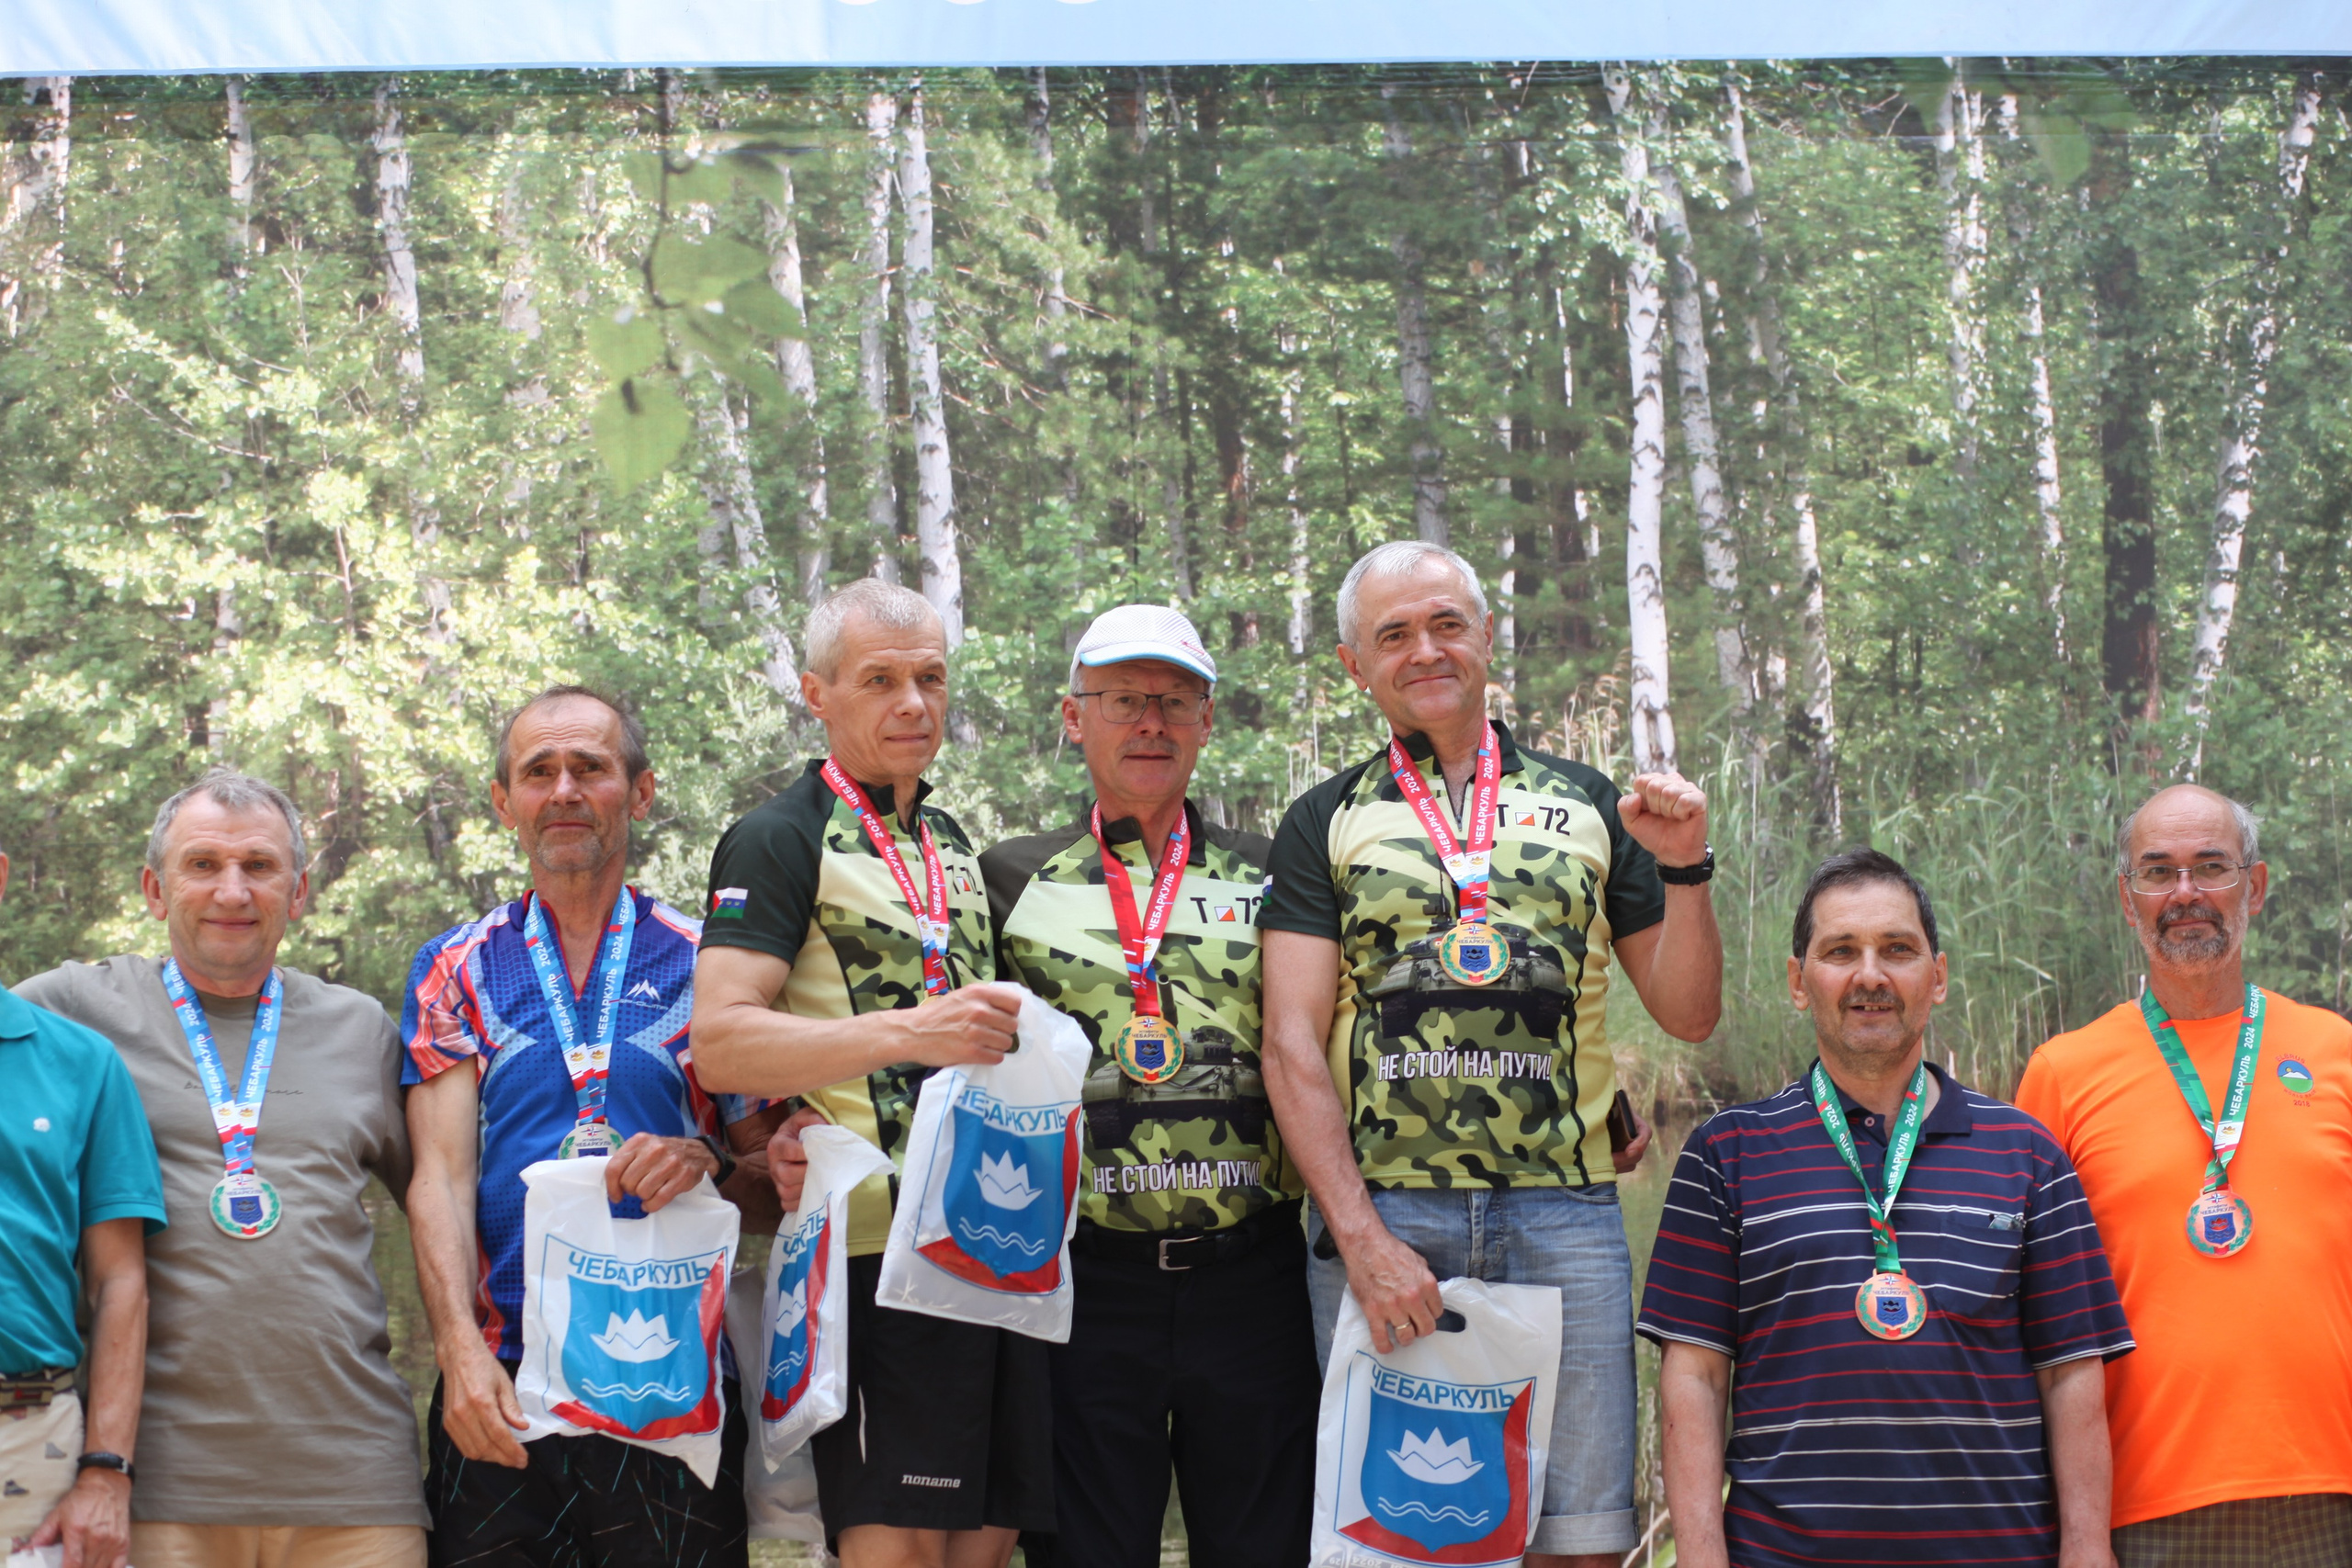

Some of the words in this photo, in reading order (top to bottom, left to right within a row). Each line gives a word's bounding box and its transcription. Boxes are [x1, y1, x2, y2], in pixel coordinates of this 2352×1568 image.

[1402, 771, 1420, 794] 2024
[1475, 786, 1491, 844] ЧЕБАРКУЛЬ
[1484, 758, 1495, 780] 2024
[863, 813, 885, 839] 2024
[1419, 797, 1452, 852] ЧЕБАРКУЛЬ
[1538, 806, 1570, 836] 72
[885, 845, 921, 910] ЧЕБАРКУЛЬ
[928, 854, 942, 915] ЧЕБАРКУЛЬ
[1148, 872, 1175, 931] ЧЕБАРКУЛЬ
[1170, 842, 1184, 866] 2024
[537, 941, 551, 966] 2024
[547, 973, 574, 1042] ЧЕБАРКУЛЬ
[596, 968, 617, 1038] ЧЕБАРКУЛЬ
[610, 936, 625, 961] 2024
[184, 1002, 200, 1026] 2024
[197, 1033, 222, 1098] ЧЕБАРКУЛЬ
[244, 1038, 268, 1098] ЧЕБАРКУЛЬ
[261, 1008, 274, 1032] 2024
[1378, 1054, 1400, 1081] НЕ
[1403, 1045, 1458, 1078] СТОЙ
[1464, 1050, 1494, 1077] НА
[1498, 1051, 1553, 1081] ПУТИ!
[2229, 1055, 2251, 1116] ЧЕБАРКУЛЬ
[2244, 1026, 2256, 1049] 2024
[1825, 1103, 1840, 1129] 2024
[1887, 1132, 1910, 1193] ЧЕБАРКУЛЬ
[1905, 1103, 1918, 1127] 2024
[1092, 1167, 1118, 1194] НЕ
[1121, 1157, 1178, 1193] СТОЙ
[1182, 1161, 1214, 1190] НА
[1216, 1160, 1261, 1188] ПУТИ!
[568, 1250, 710, 1287] ЧЕБАРКУЛЬ
[1372, 1363, 1516, 1409] ЧЕБАРКУЛЬ
[901, 1473, 961, 1488] noname
